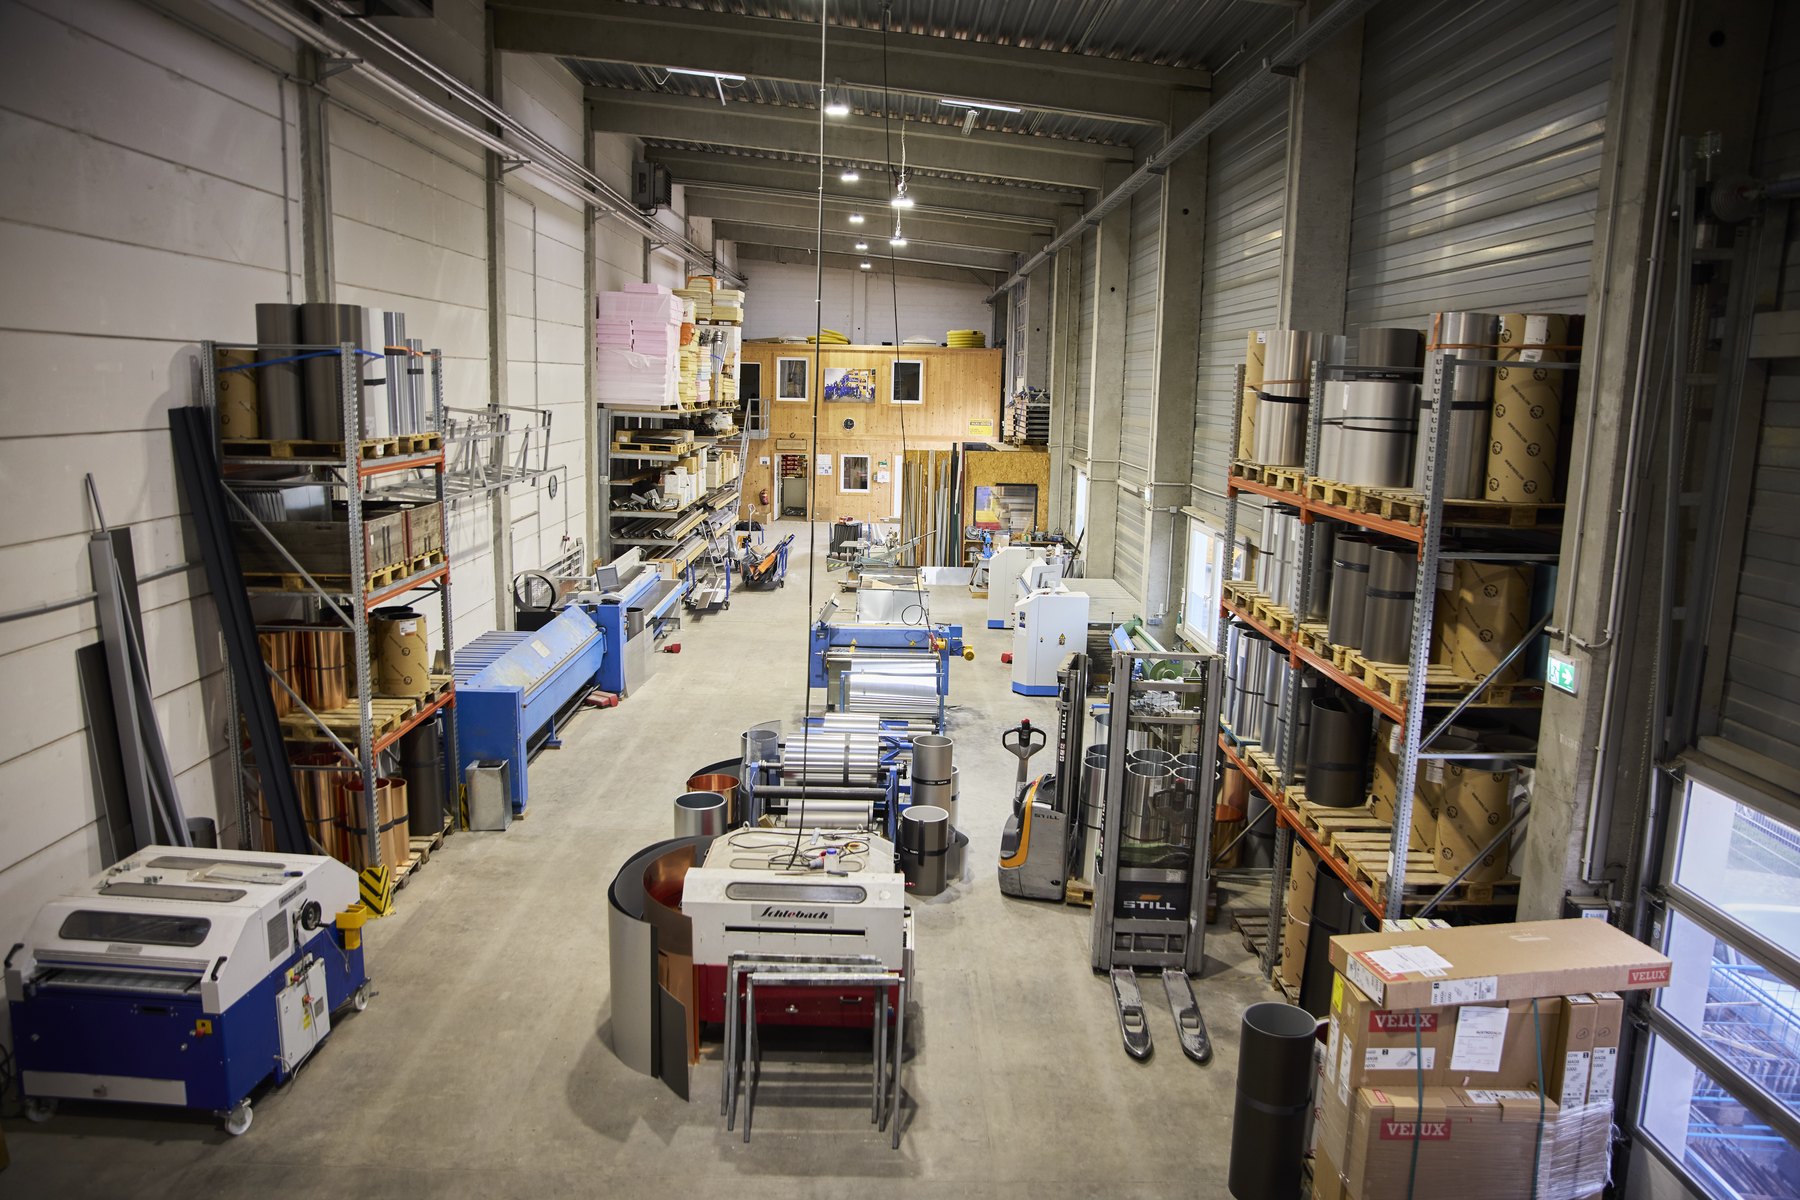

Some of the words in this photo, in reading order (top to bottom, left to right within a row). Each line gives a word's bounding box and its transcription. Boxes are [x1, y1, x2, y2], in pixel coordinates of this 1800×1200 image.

[1123, 900, 1177, 911] STILL
[761, 906, 829, 919] Schlebach
[1632, 970, 1666, 981] VELUX
[1375, 1014, 1432, 1028] VELUX
